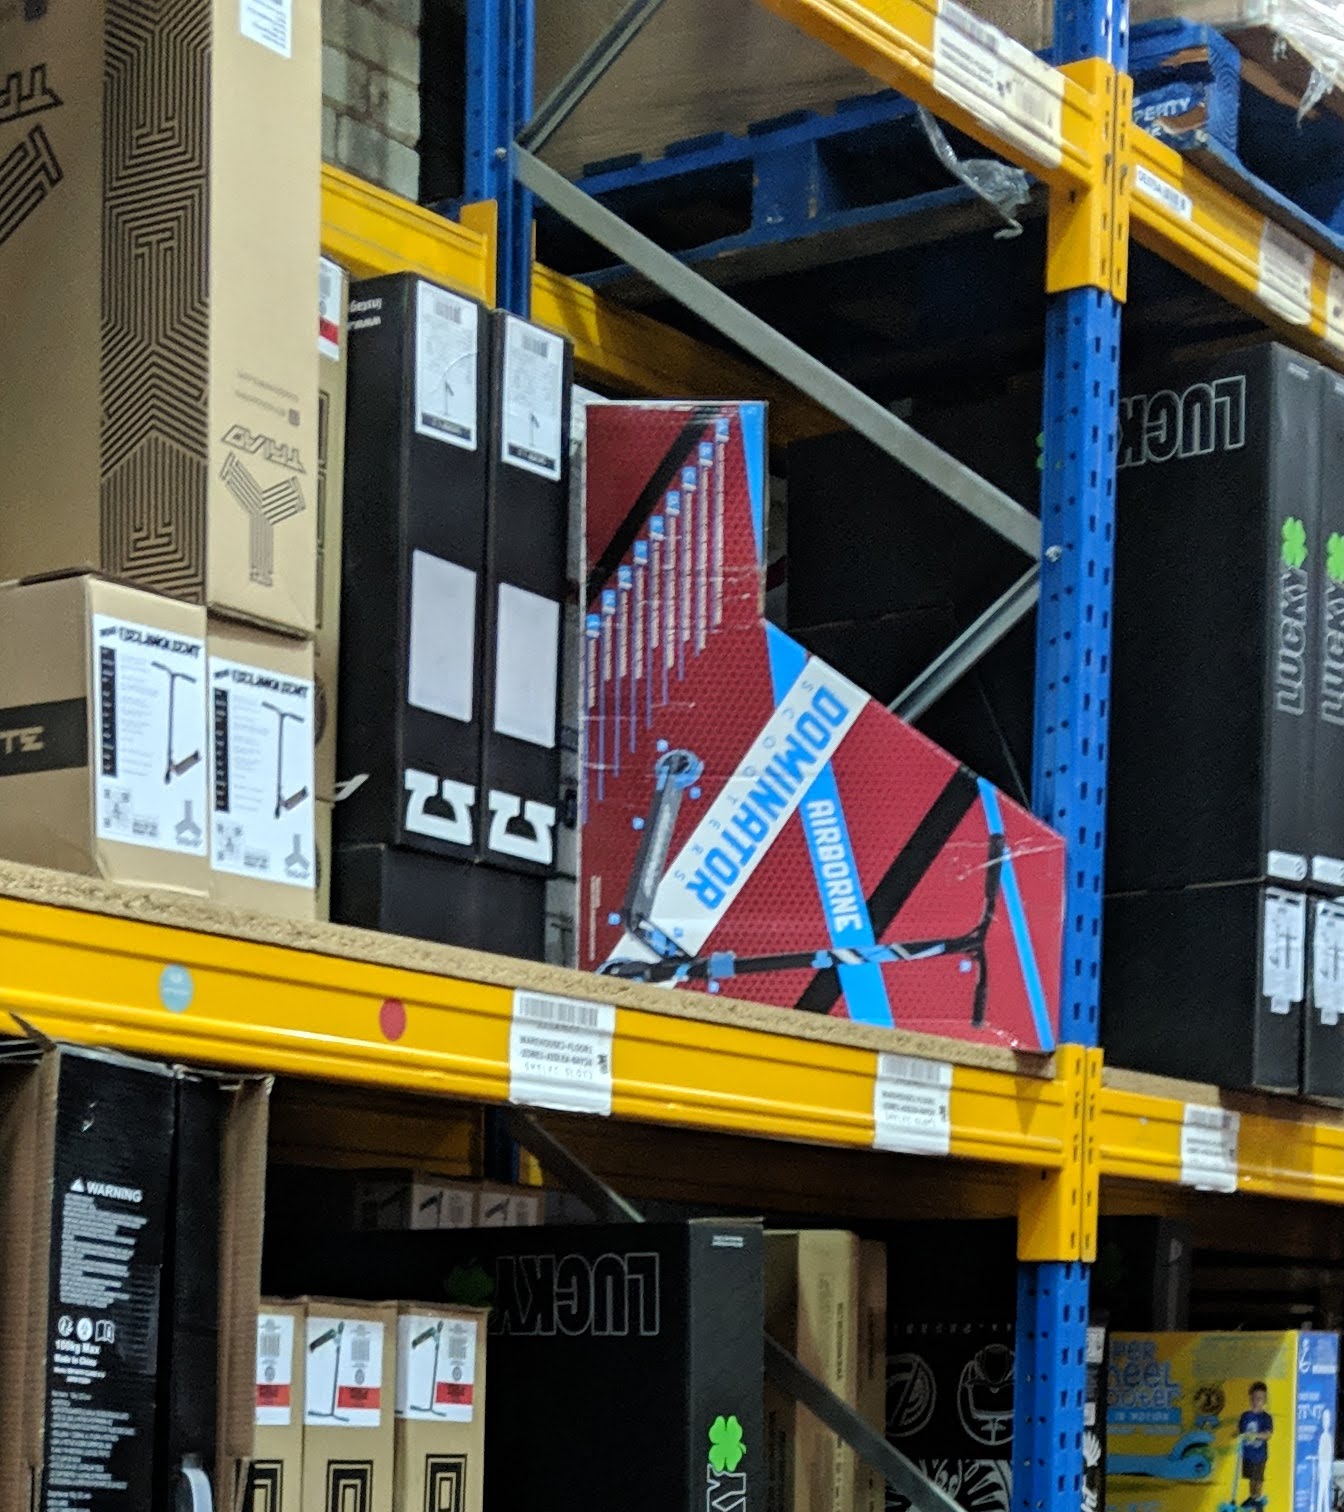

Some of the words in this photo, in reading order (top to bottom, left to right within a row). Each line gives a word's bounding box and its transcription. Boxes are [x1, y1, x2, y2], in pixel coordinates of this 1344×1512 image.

[1117, 375, 1247, 470] LUCK
[1277, 566, 1309, 716] LUCKY
[675, 680, 814, 882] SCOOTERS
[686, 685, 850, 910] DOMINATOR
[807, 800, 862, 933] AIRBORNE
[87, 1181, 144, 1203] WARNING
[491, 1253, 660, 1336] LUCKY
